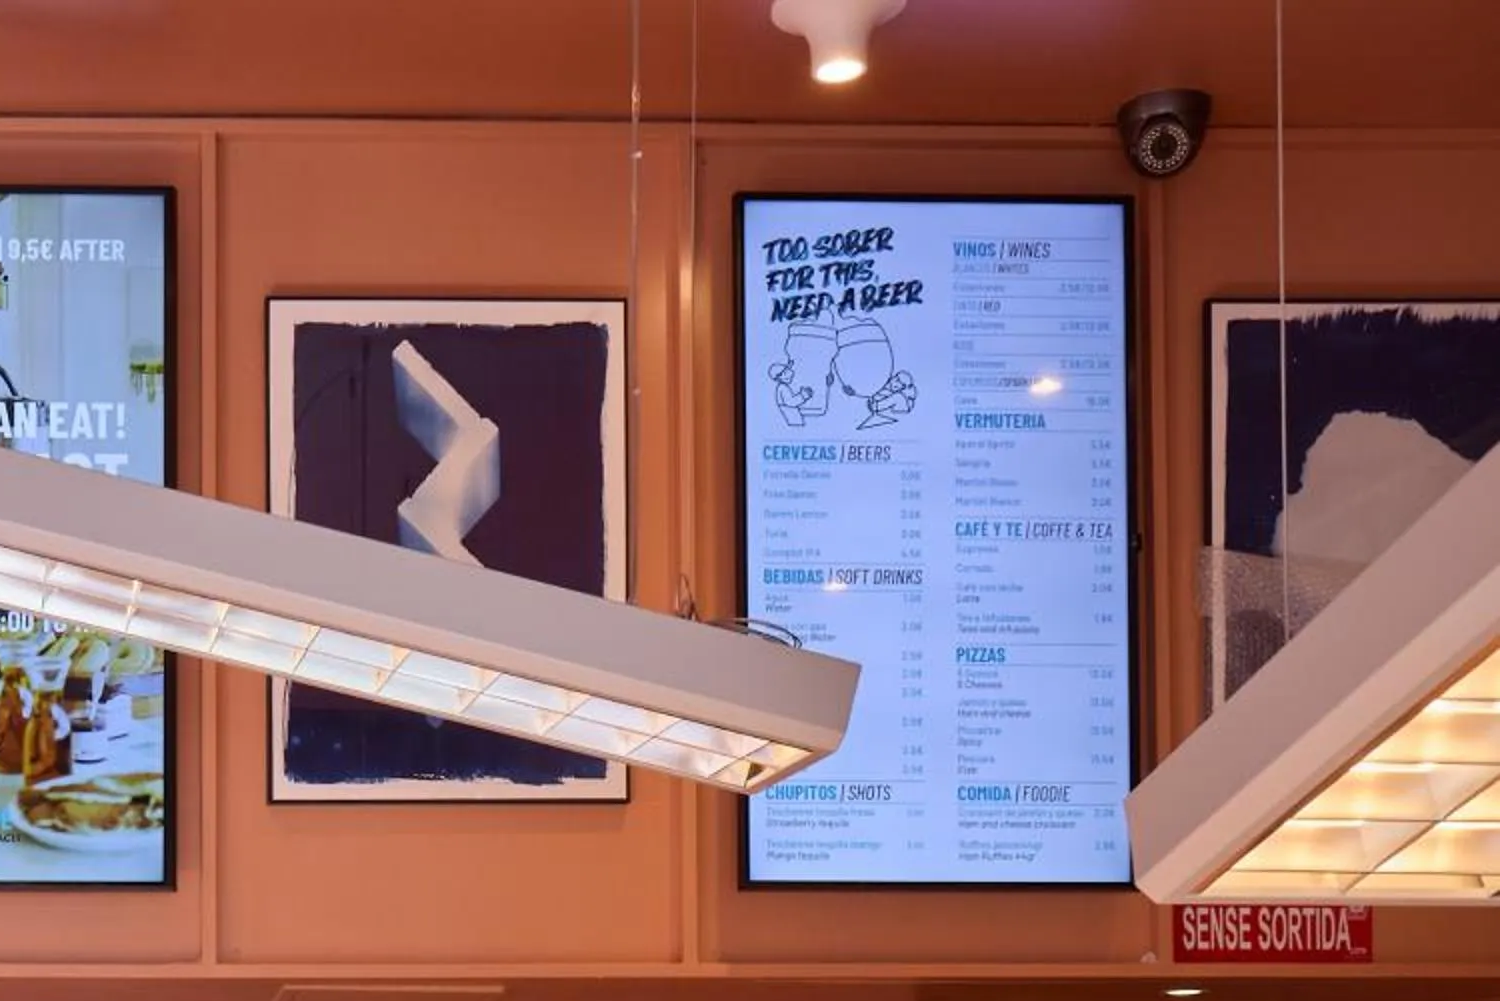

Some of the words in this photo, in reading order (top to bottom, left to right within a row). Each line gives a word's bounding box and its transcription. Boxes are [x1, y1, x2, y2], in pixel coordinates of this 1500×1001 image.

[60, 239, 125, 261] AFTER
[762, 236, 809, 264] TOO
[812, 227, 894, 258] SOBER
[953, 242, 996, 258] VINOS
[1008, 241, 1051, 259] WINES
[766, 265, 815, 291] FOR
[771, 292, 835, 322] NEED
[838, 288, 855, 313] A
[860, 280, 923, 312] BEER
[50, 402, 126, 439] EAT!
[955, 413, 1046, 429] VERMUTERIA
[763, 445, 837, 461] CERVEZAS
[848, 446, 891, 461] BEERS
[955, 517, 989, 537] CAFÉ
[993, 522, 1002, 537] Y
[1006, 522, 1023, 537] TE
[1033, 522, 1071, 538] COFFE
[1090, 522, 1114, 539] TEA
[763, 568, 825, 585] BEBIDAS
[836, 568, 871, 585] SOFT
[873, 568, 923, 586] DRINKS
[956, 647, 1006, 663] PIZZAS
[765, 784, 837, 801] CHUPITOS
[847, 784, 892, 801] SHOTS
[957, 785, 1012, 801] COMIDA
[1023, 785, 1071, 802] FOODIE
[1182, 906, 1252, 950] SENSE
[1258, 907, 1351, 950] SORTIDA
